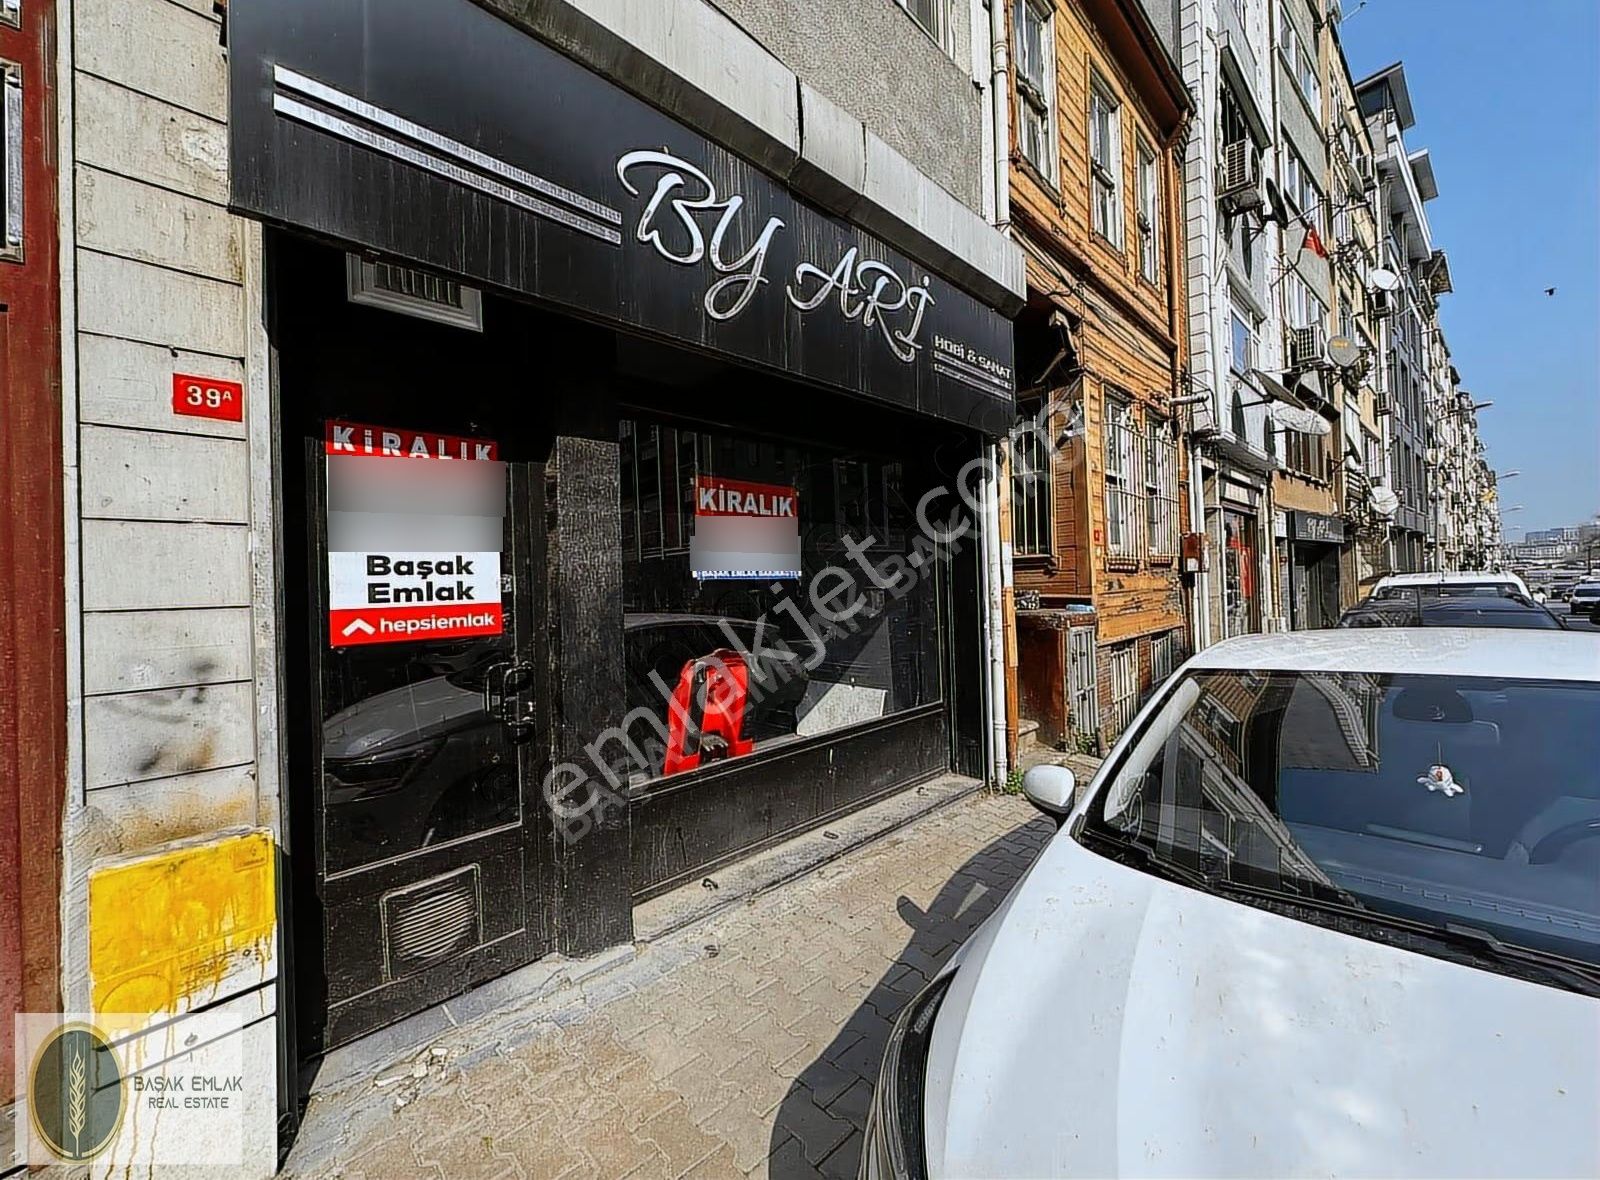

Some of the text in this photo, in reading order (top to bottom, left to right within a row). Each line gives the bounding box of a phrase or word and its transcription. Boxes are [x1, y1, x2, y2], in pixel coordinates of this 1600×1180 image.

[366, 555, 474, 579] Başak
[367, 581, 475, 604] Emlak
[380, 612, 495, 635] hepsiemlak
